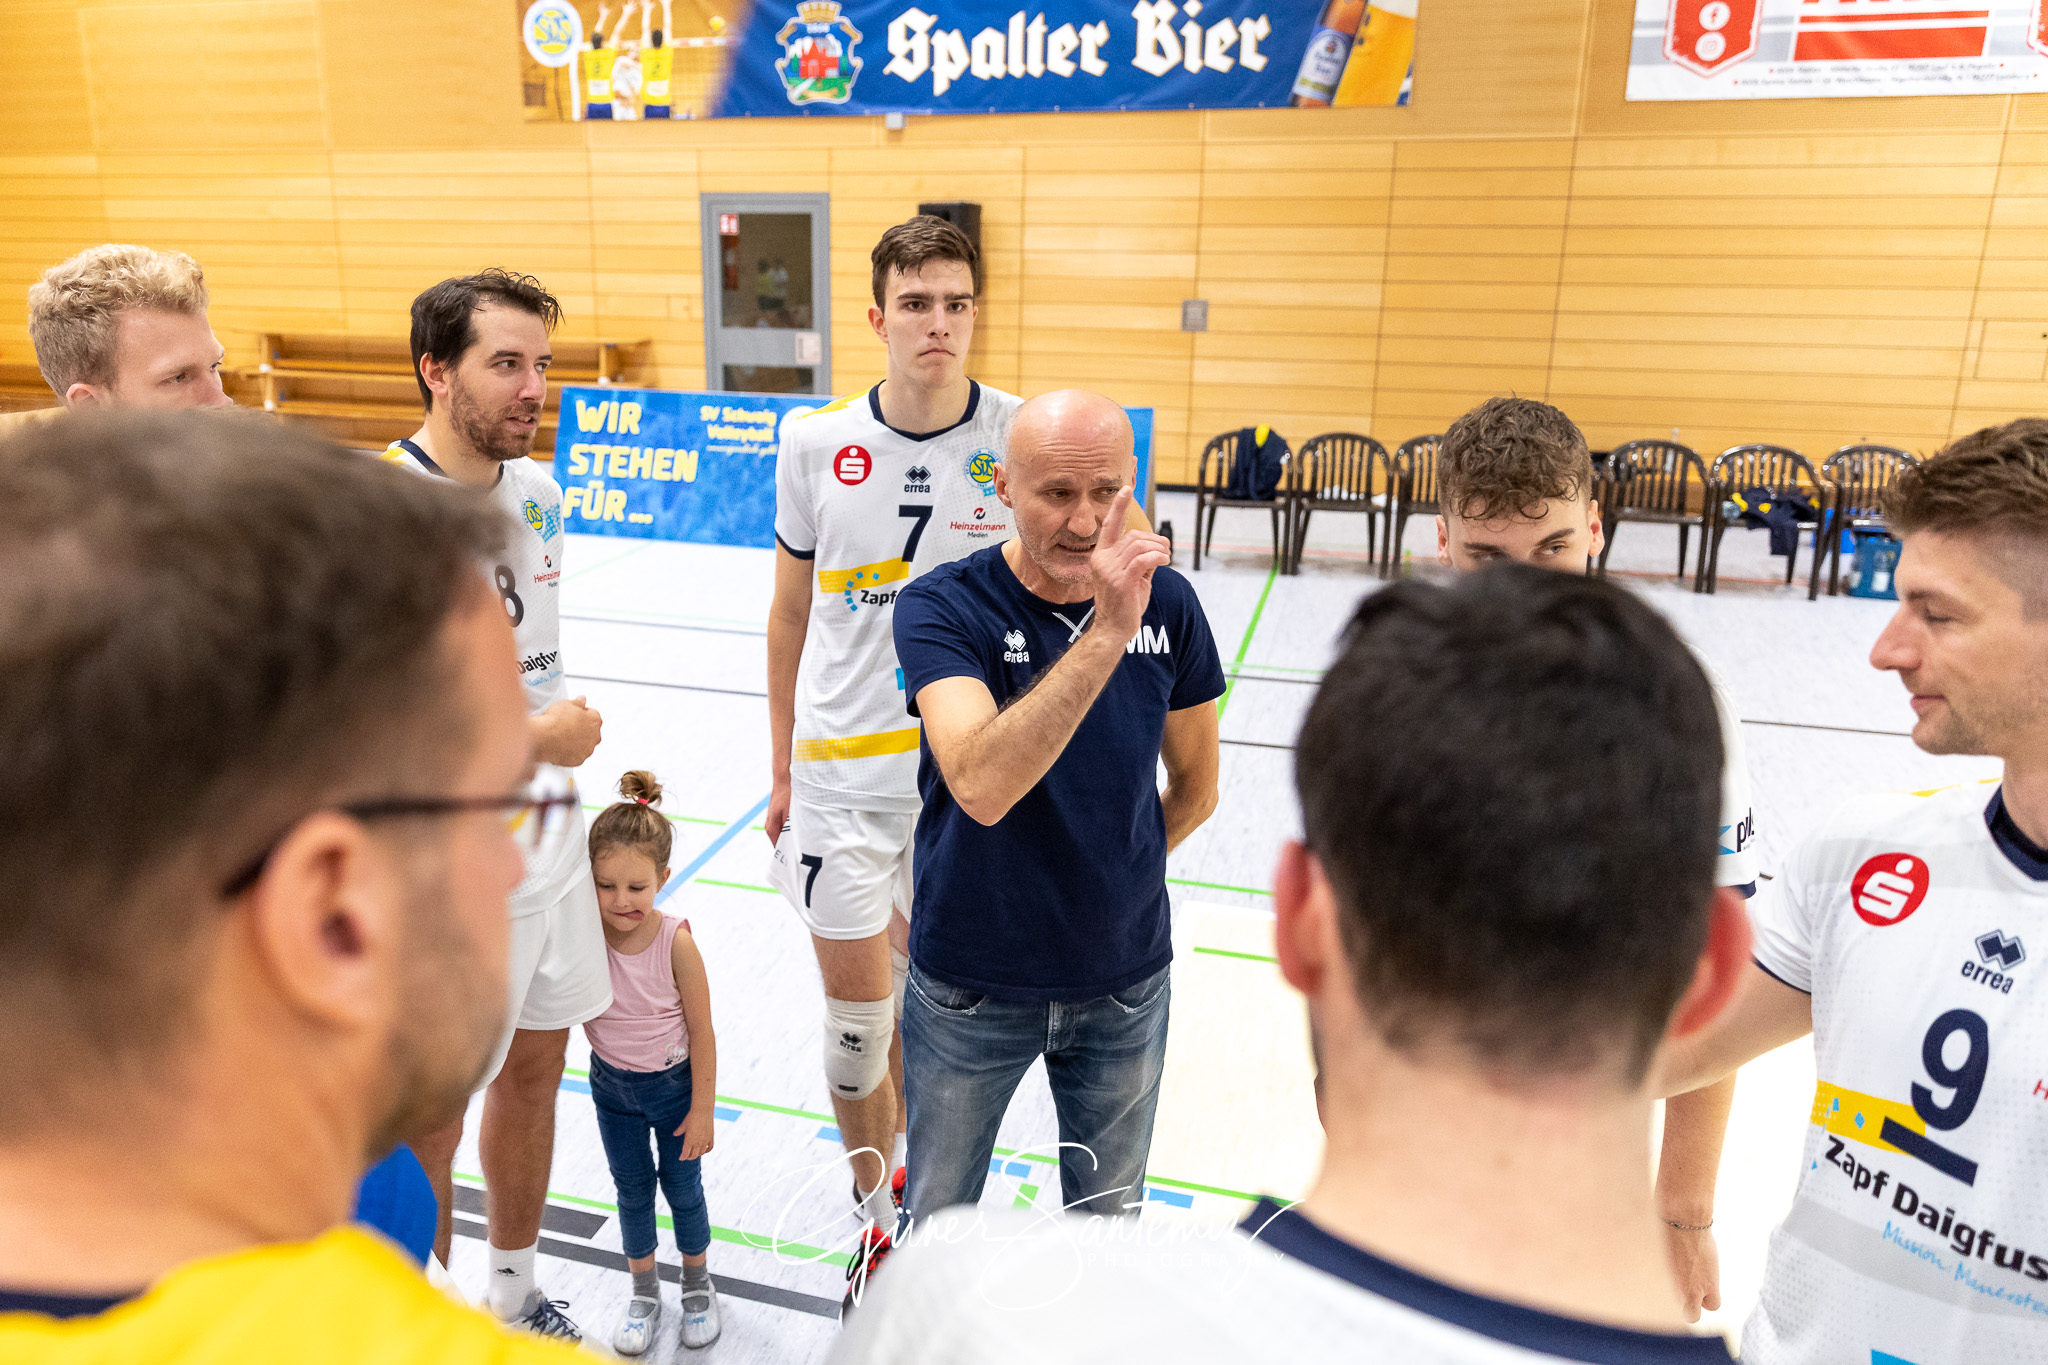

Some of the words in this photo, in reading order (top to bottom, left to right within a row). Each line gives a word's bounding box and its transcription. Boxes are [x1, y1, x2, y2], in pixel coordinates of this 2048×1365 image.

[883, 7, 1110, 97] Spalter
[1132, 0, 1272, 77] Bier
[575, 400, 642, 434] WIR
[568, 443, 699, 483] STEHEN
[904, 484, 930, 493] errea
[898, 504, 934, 562] 7
[950, 521, 1006, 531] Heinzelmann
[494, 565, 524, 627] 8
[860, 590, 897, 607] Zapf
[1004, 651, 1030, 663] errea
[800, 853, 823, 908] 7
[1961, 960, 2014, 994] errea
[1911, 1008, 1989, 1131] 9
[1825, 1135, 1889, 1199] Zapf
[1882, 1220, 1945, 1270] Mission
